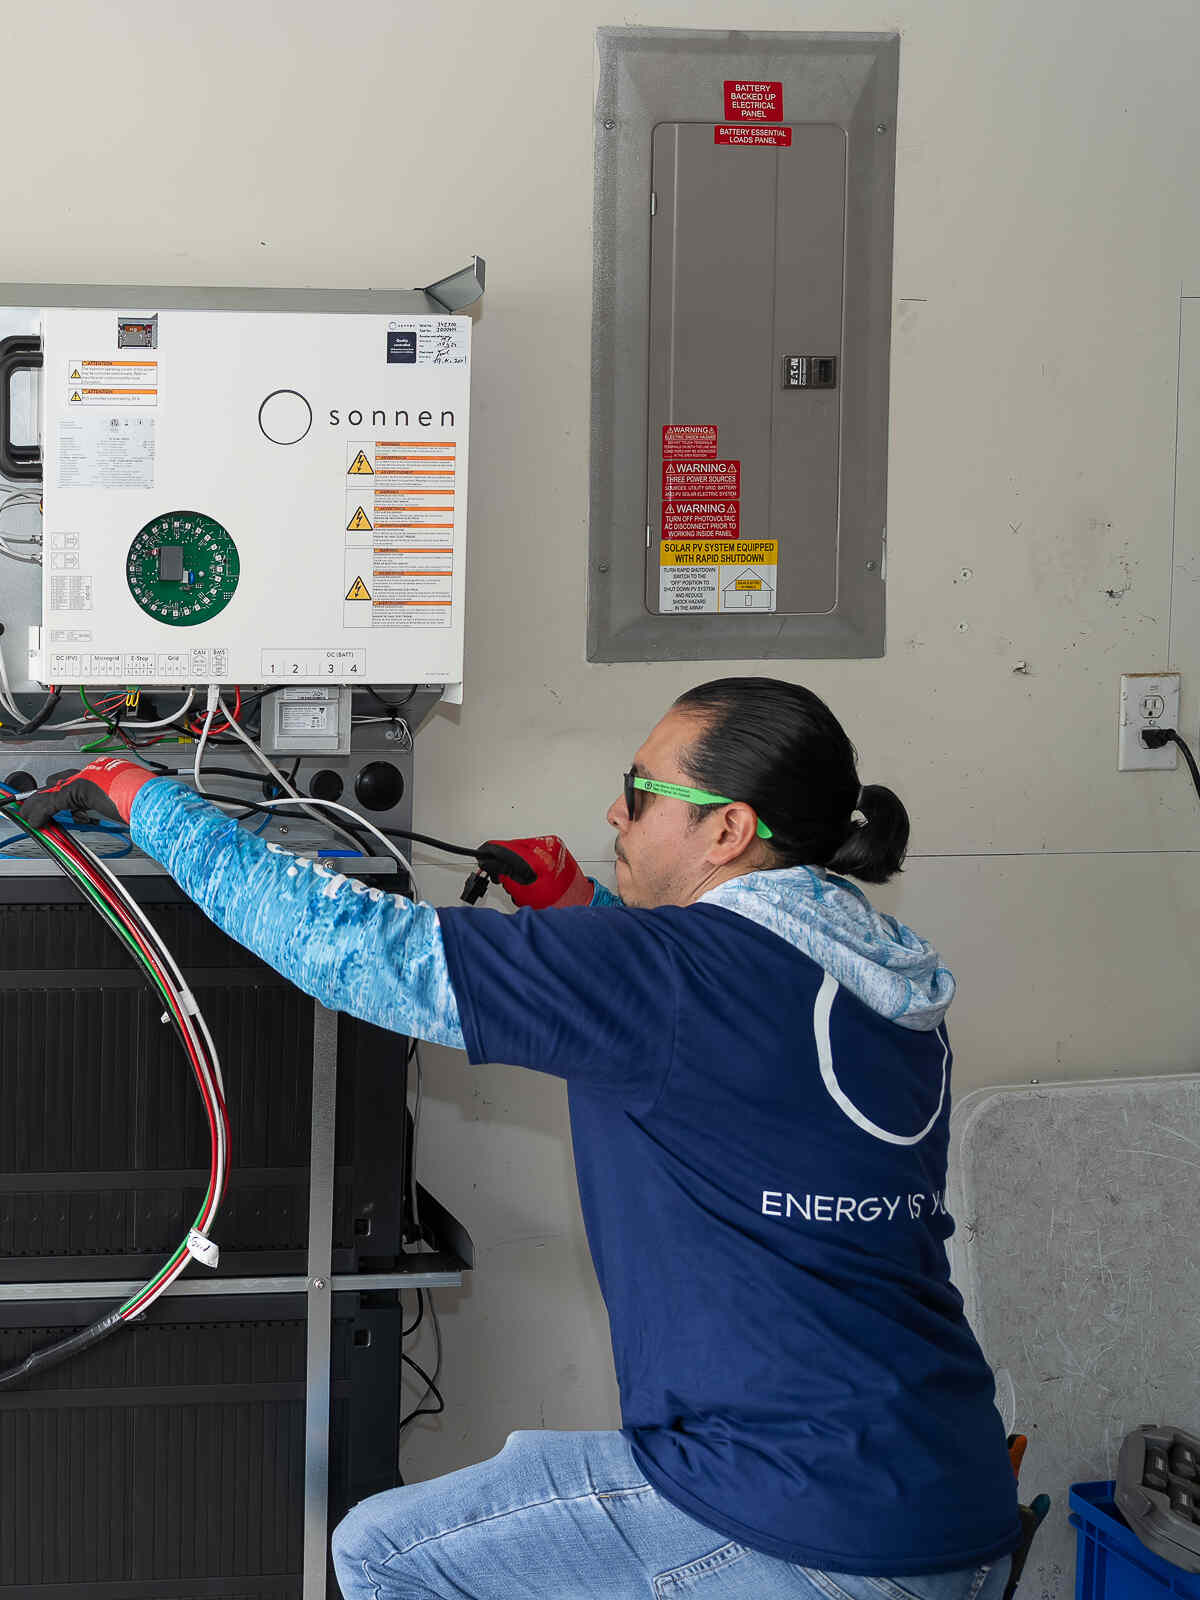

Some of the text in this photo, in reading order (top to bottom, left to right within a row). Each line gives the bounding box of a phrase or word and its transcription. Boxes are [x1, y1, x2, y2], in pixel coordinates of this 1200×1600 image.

[735, 84, 771, 92] BATTERY
[764, 93, 777, 101] UP
[732, 101, 776, 110] ELECTRICAL
[741, 110, 767, 118] PANEL
[720, 128, 787, 137] BATTERY ESSENTIAL
[729, 136, 754, 144] LOADS
[790, 358, 799, 385] EATON
[329, 409, 455, 427] sonnen
[676, 463, 727, 473] WARNING
[676, 504, 726, 513] WARNING
[664, 543, 775, 552] SOLAR PV SYSTEM EQUIPPED
[675, 554, 765, 563] WITH RAPID SHUTDOWN
[271, 664, 357, 673] 1 2 3 4
[761, 1190, 901, 1222] ENERGY
[908, 1193, 925, 1220] IS
